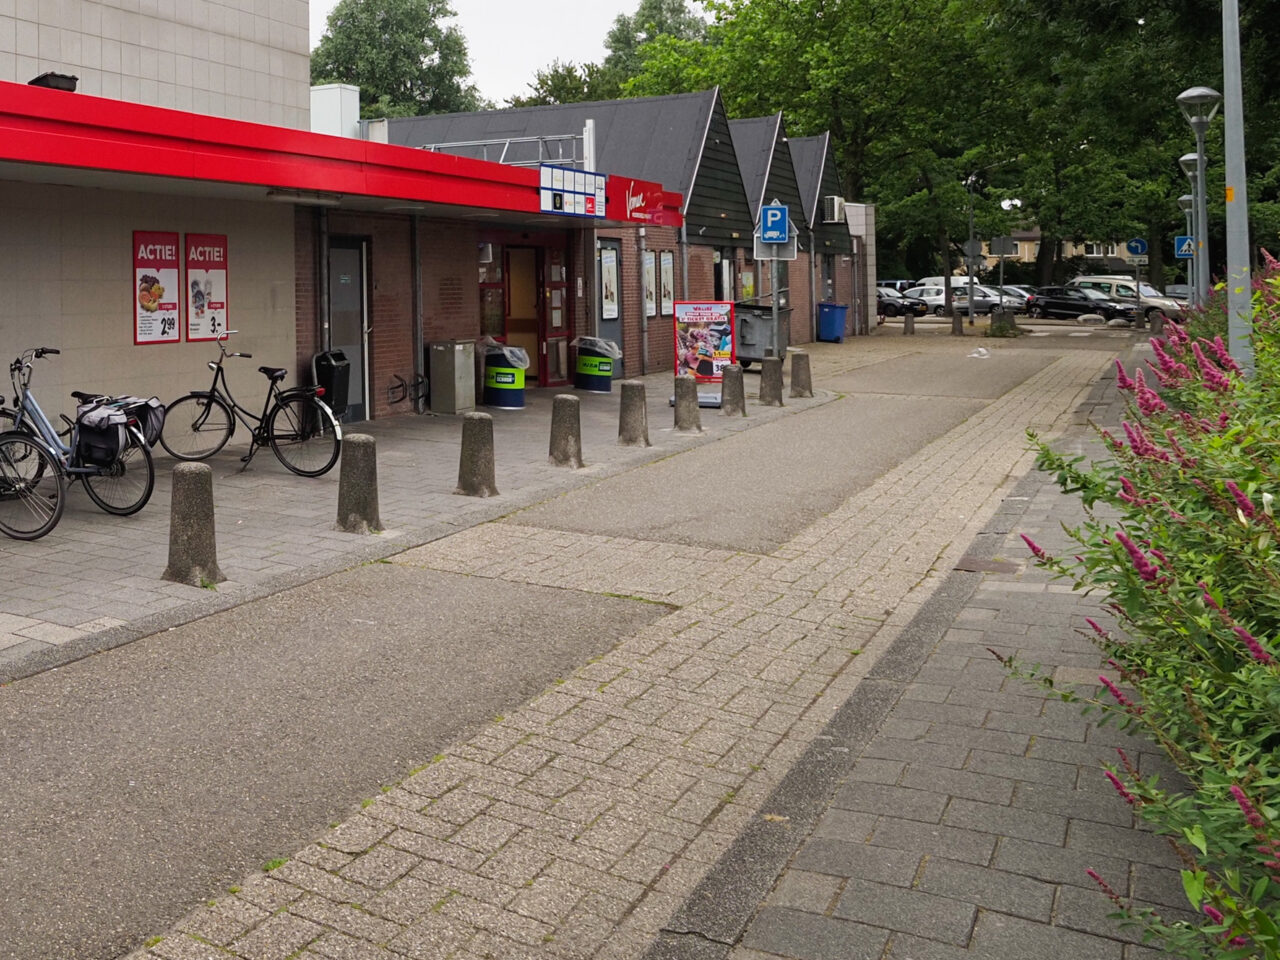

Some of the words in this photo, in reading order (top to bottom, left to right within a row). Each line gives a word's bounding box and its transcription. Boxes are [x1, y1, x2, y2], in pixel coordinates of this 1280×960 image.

[767, 209, 782, 228] P
[138, 244, 176, 260] ACTIE!
[189, 246, 224, 262] ACTIE!
